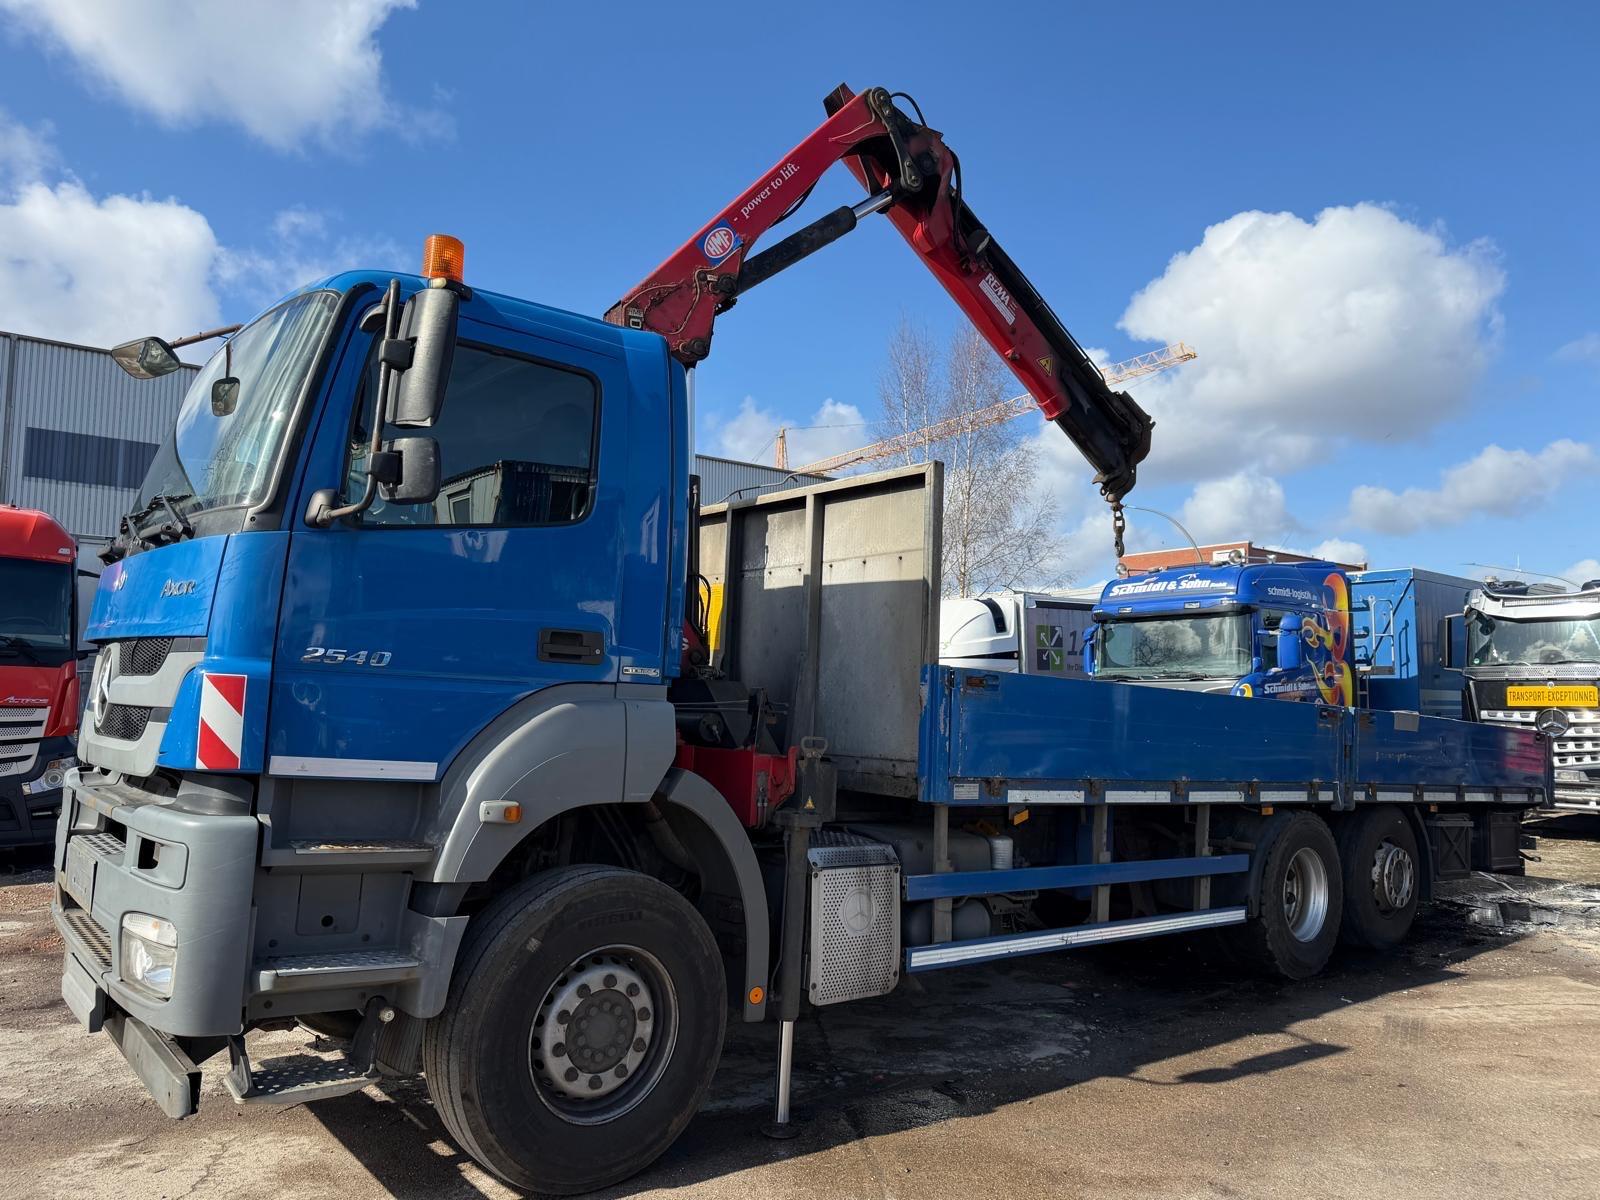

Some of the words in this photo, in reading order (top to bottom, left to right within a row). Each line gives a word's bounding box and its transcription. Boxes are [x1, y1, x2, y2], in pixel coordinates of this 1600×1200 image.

[741, 186, 771, 220] power
[771, 177, 783, 190] to
[780, 163, 801, 181] lift.
[706, 230, 731, 255] HMF
[985, 272, 1010, 306] REMA
[1167, 580, 1177, 590] &
[1179, 579, 1211, 590] Sohn
[300, 646, 393, 667] 2540
[1508, 690, 1598, 702] TRANSPORT-EXCEPTIONNEL
